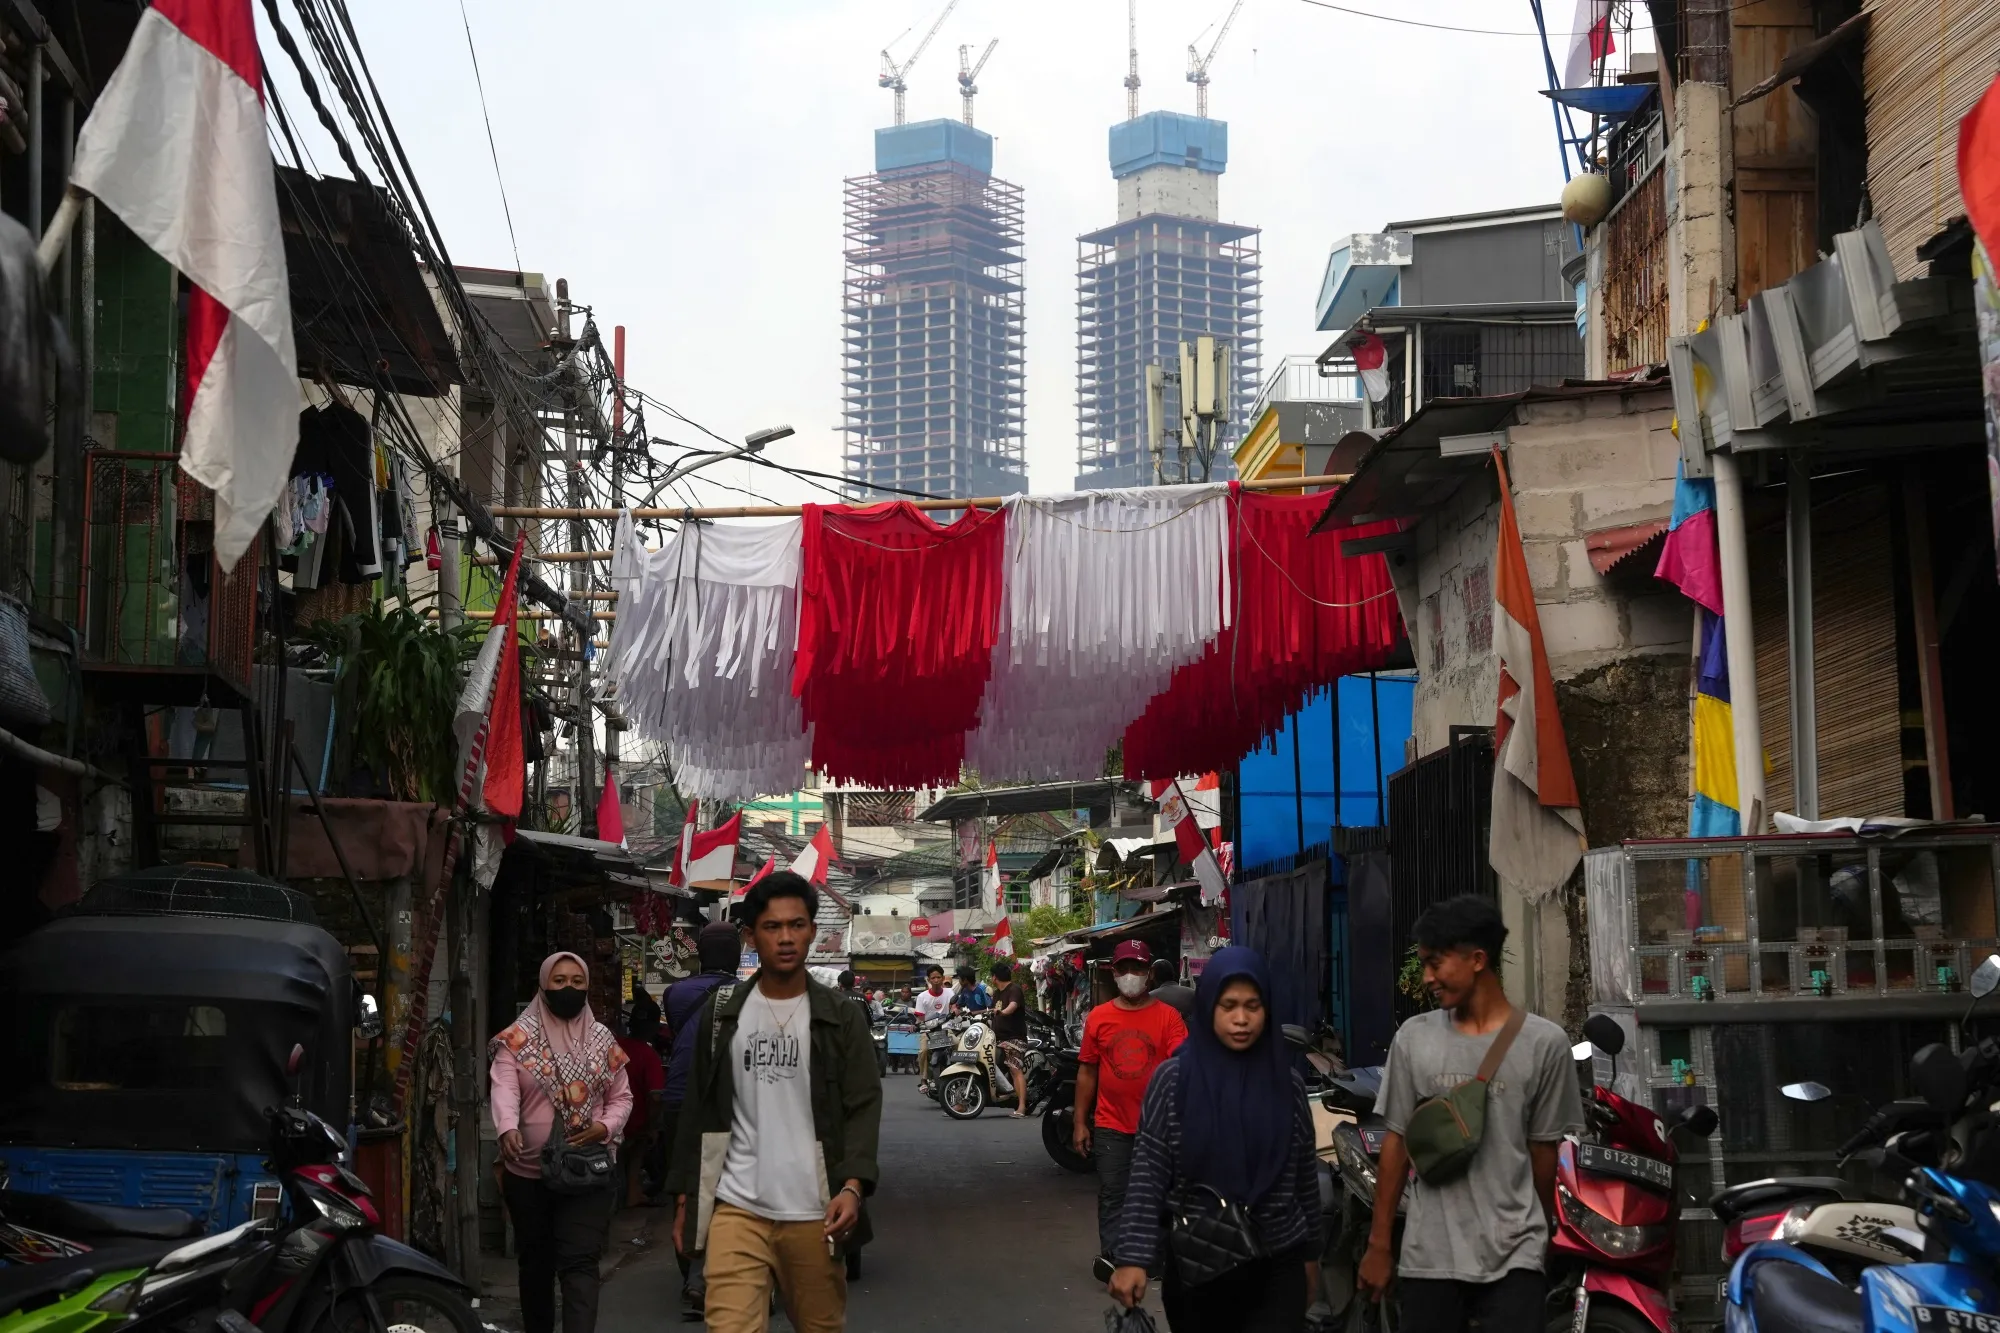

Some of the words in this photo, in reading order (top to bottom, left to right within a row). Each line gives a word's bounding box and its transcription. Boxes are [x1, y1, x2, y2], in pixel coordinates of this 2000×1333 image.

[747, 1036, 799, 1068] YEAH!
[982, 1043, 997, 1089] Supreme
[1366, 1132, 1375, 1142] B
[1584, 1146, 1593, 1156] B
[1604, 1149, 1639, 1167] 6123
[1646, 1159, 1671, 1178] PUH
[1916, 1307, 1932, 1323] B
